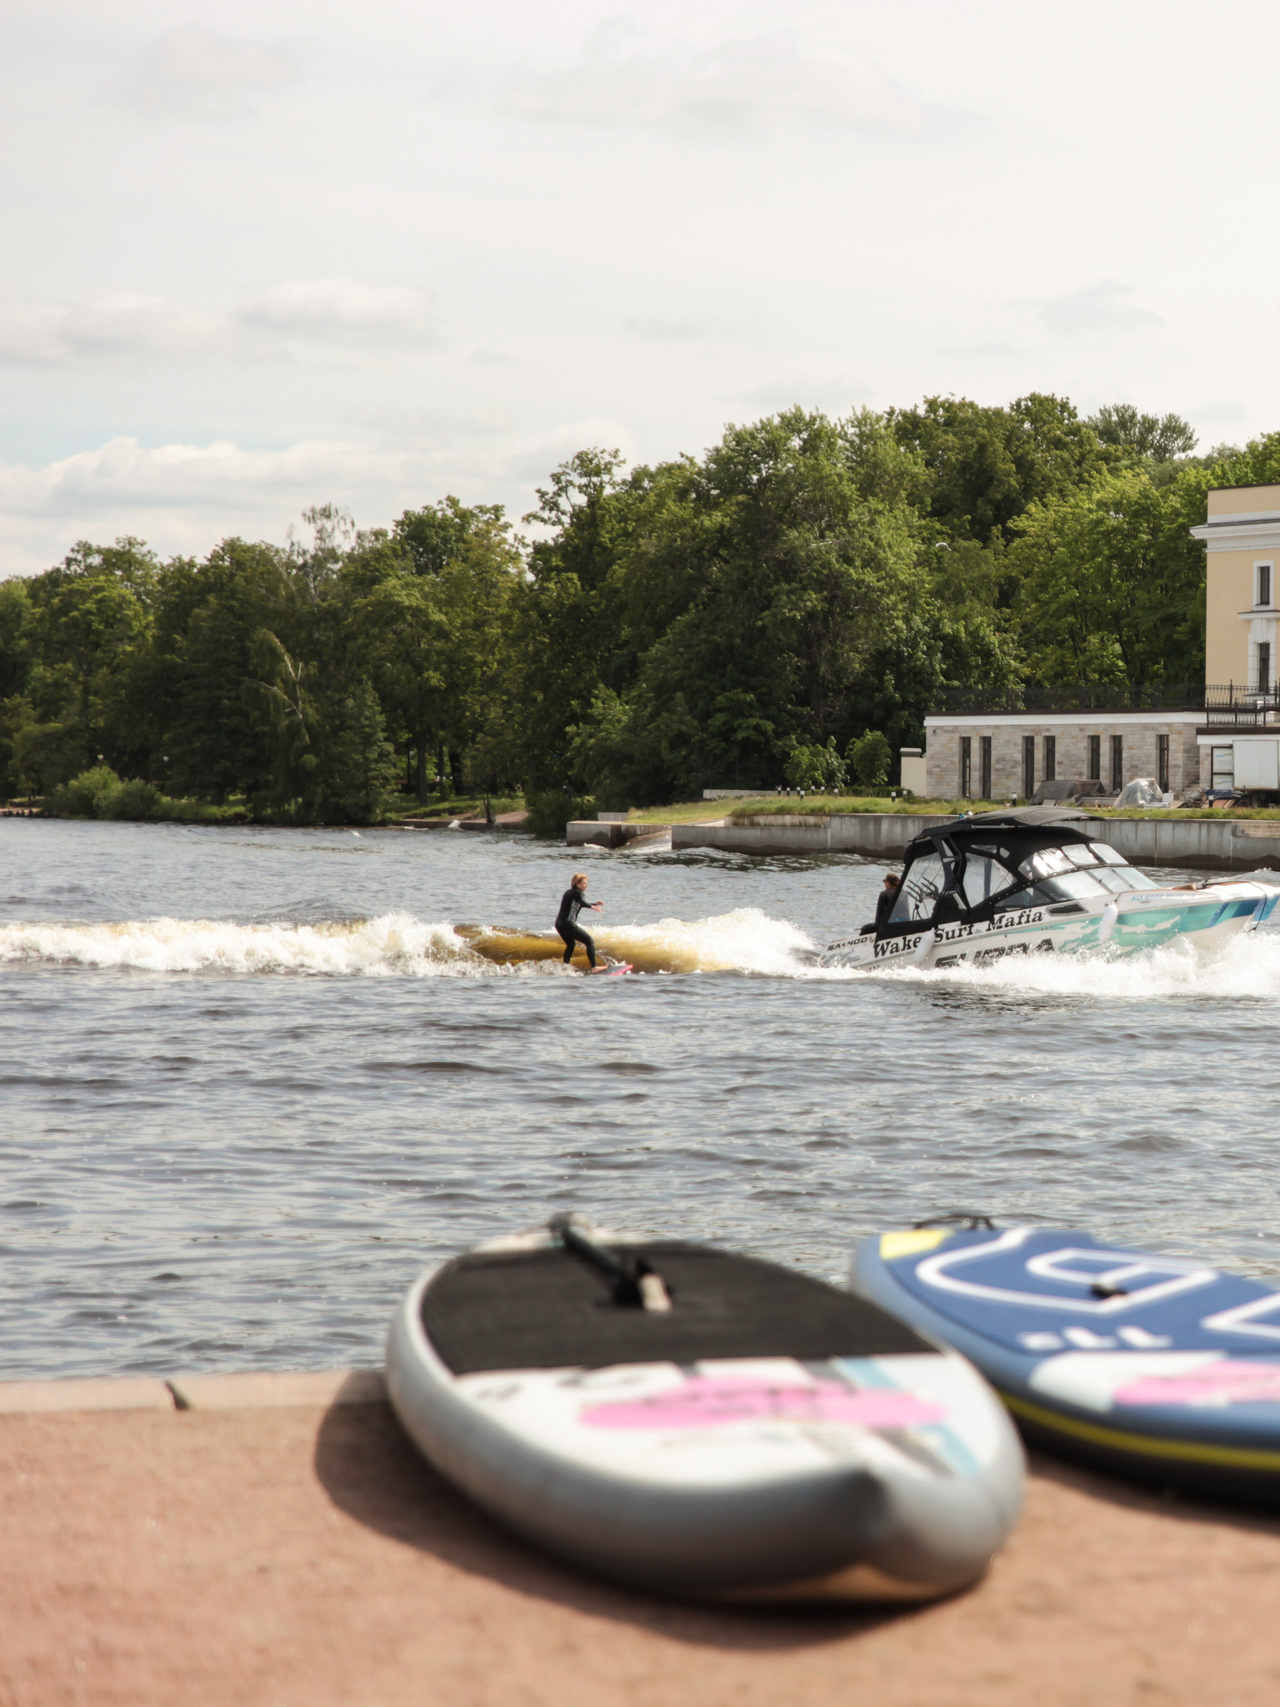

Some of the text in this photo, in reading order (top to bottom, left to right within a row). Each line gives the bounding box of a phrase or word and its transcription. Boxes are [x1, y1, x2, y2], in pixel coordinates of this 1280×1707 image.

[873, 908, 1044, 958] Wake Surf Mafia
